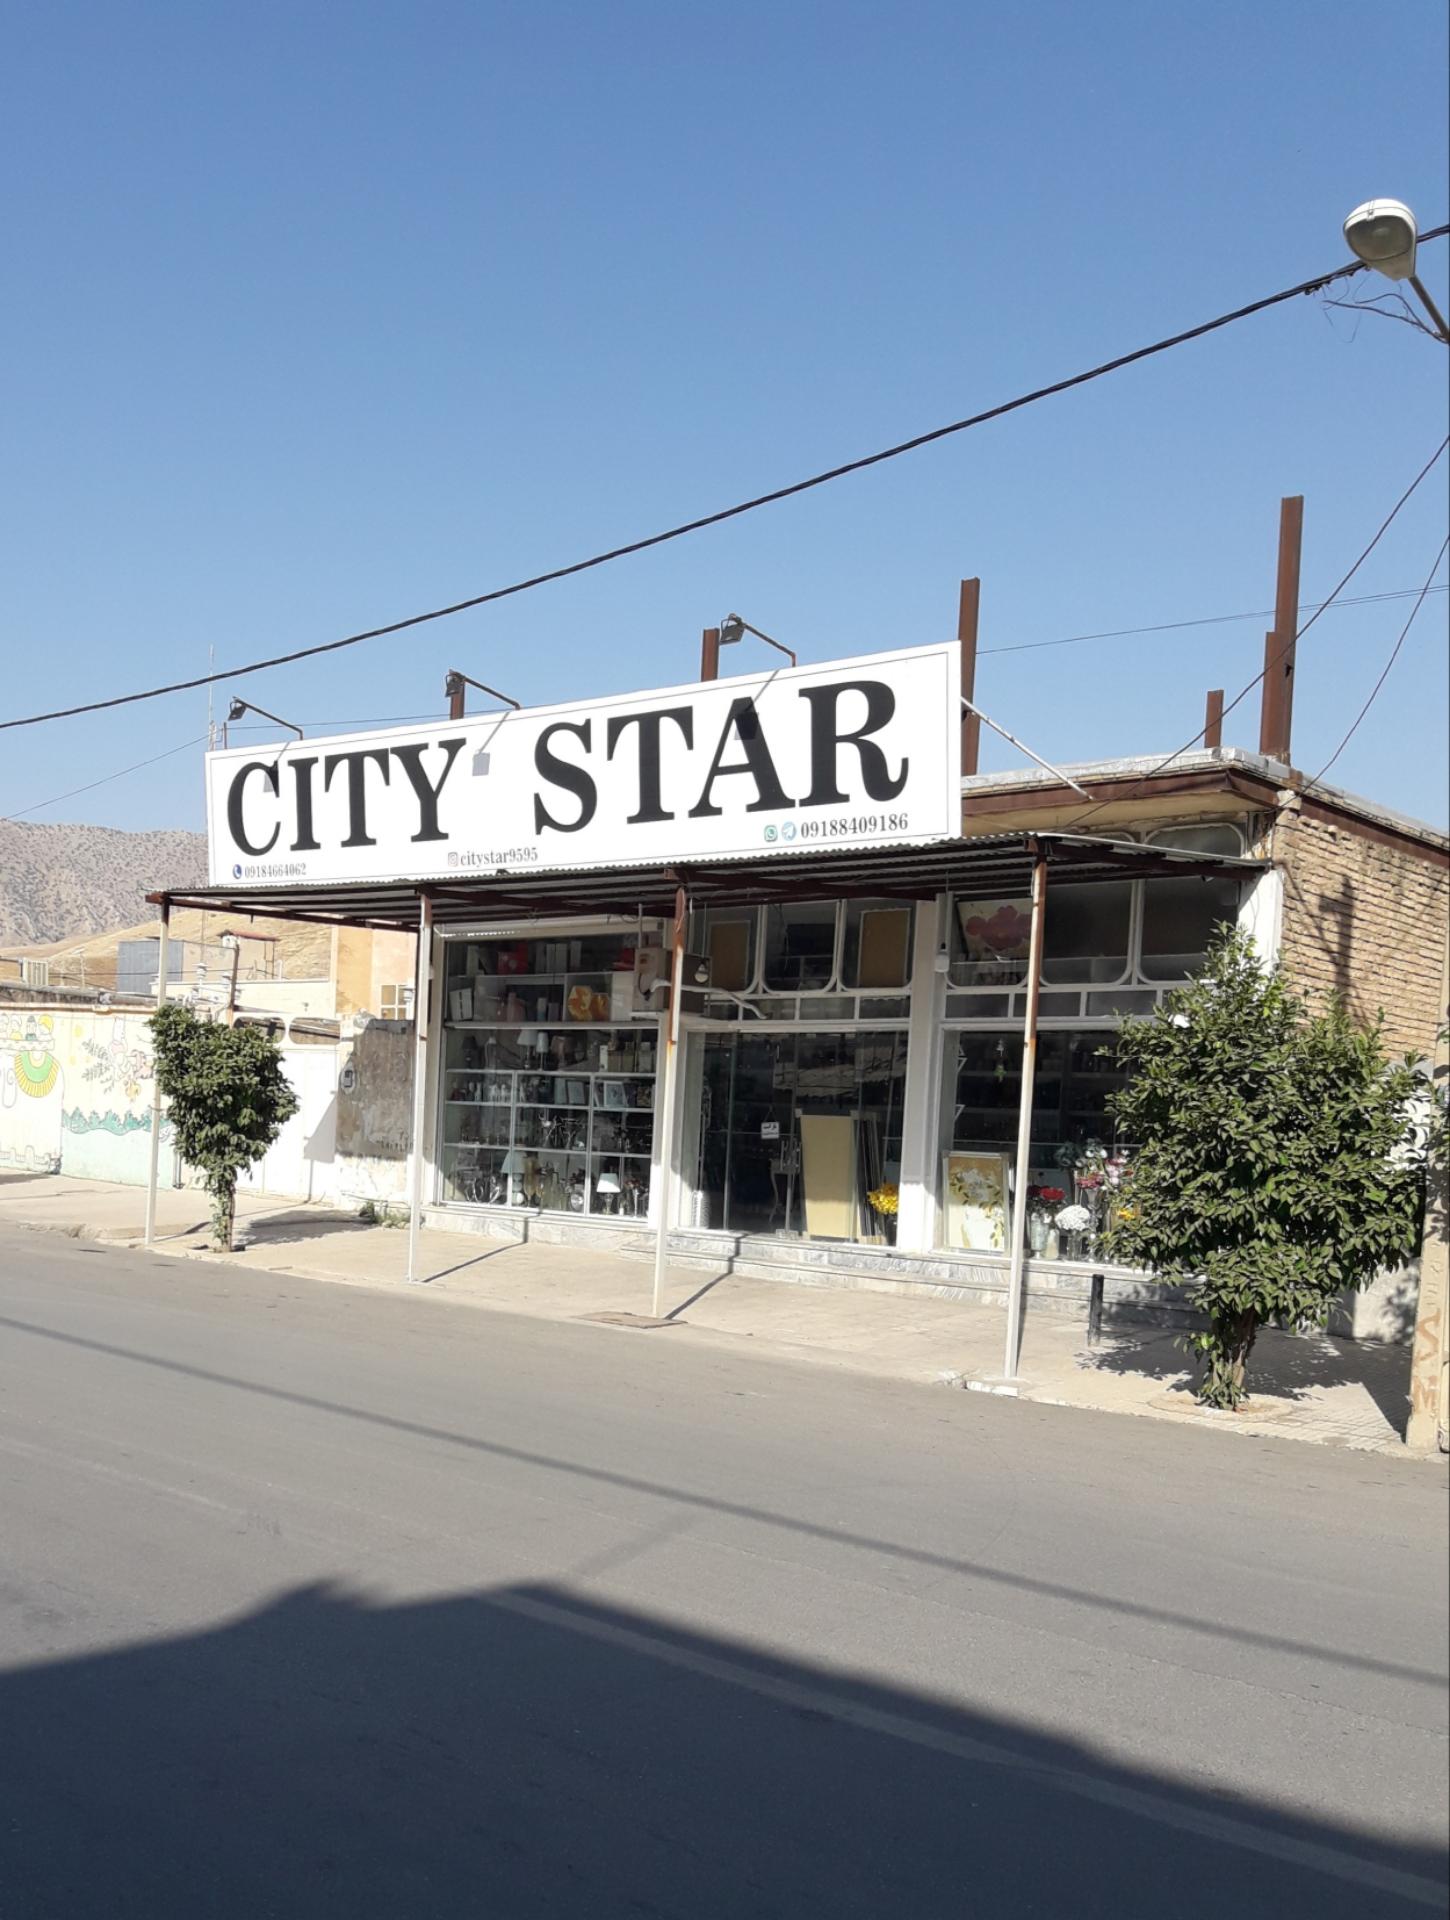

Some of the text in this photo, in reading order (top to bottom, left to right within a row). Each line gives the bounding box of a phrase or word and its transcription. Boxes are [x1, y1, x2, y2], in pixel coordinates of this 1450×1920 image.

[227, 680, 909, 856] CITY STAR
[800, 813, 908, 838] 09188409186
[460, 847, 538, 867] citystar9595
[244, 862, 307, 878] 09184664062
